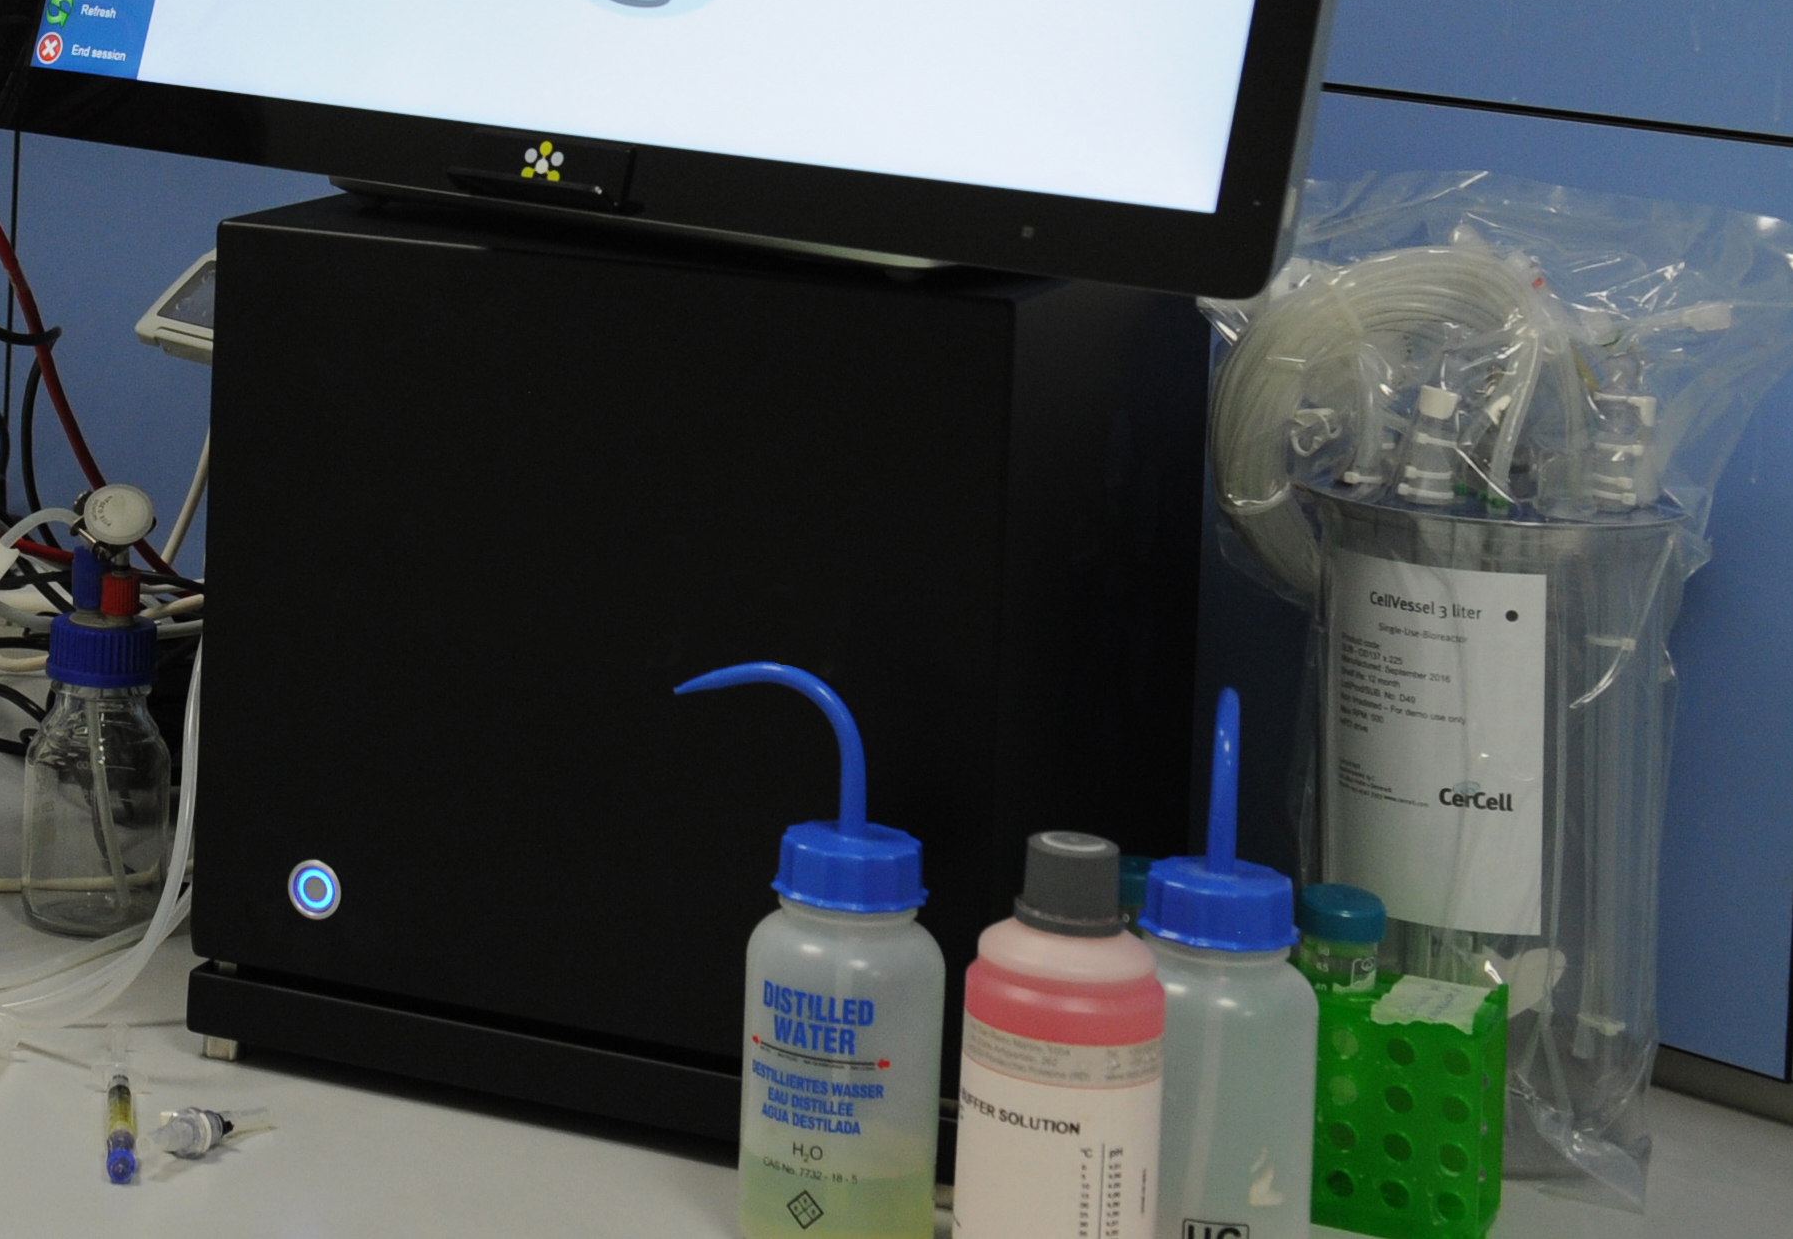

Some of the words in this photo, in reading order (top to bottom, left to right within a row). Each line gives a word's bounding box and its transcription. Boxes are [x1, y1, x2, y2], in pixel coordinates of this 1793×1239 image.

[81, 3, 116, 19] Refresh
[71, 43, 90, 58] End
[92, 46, 126, 61] session
[1369, 591, 1435, 615] CellVessel
[1438, 605, 1448, 619] 3
[1451, 602, 1482, 620] liter
[1438, 787, 1514, 812] CerCell
[763, 980, 874, 1027] DISTILLED
[774, 1014, 855, 1056] WATER
[752, 1059, 828, 1096] DESTILLIERTES
[832, 1082, 884, 1098] WASSER
[768, 1087, 788, 1106] EAU
[762, 1103, 789, 1124] AGUA
[793, 1113, 861, 1135] DESTILADA
[999, 1108, 1080, 1135] SOLUTION
[763, 1156, 780, 1170] CAS
[800, 1167, 822, 1181] 7732
[832, 1173, 842, 1183] 18
[852, 1175, 857, 1184] 5
